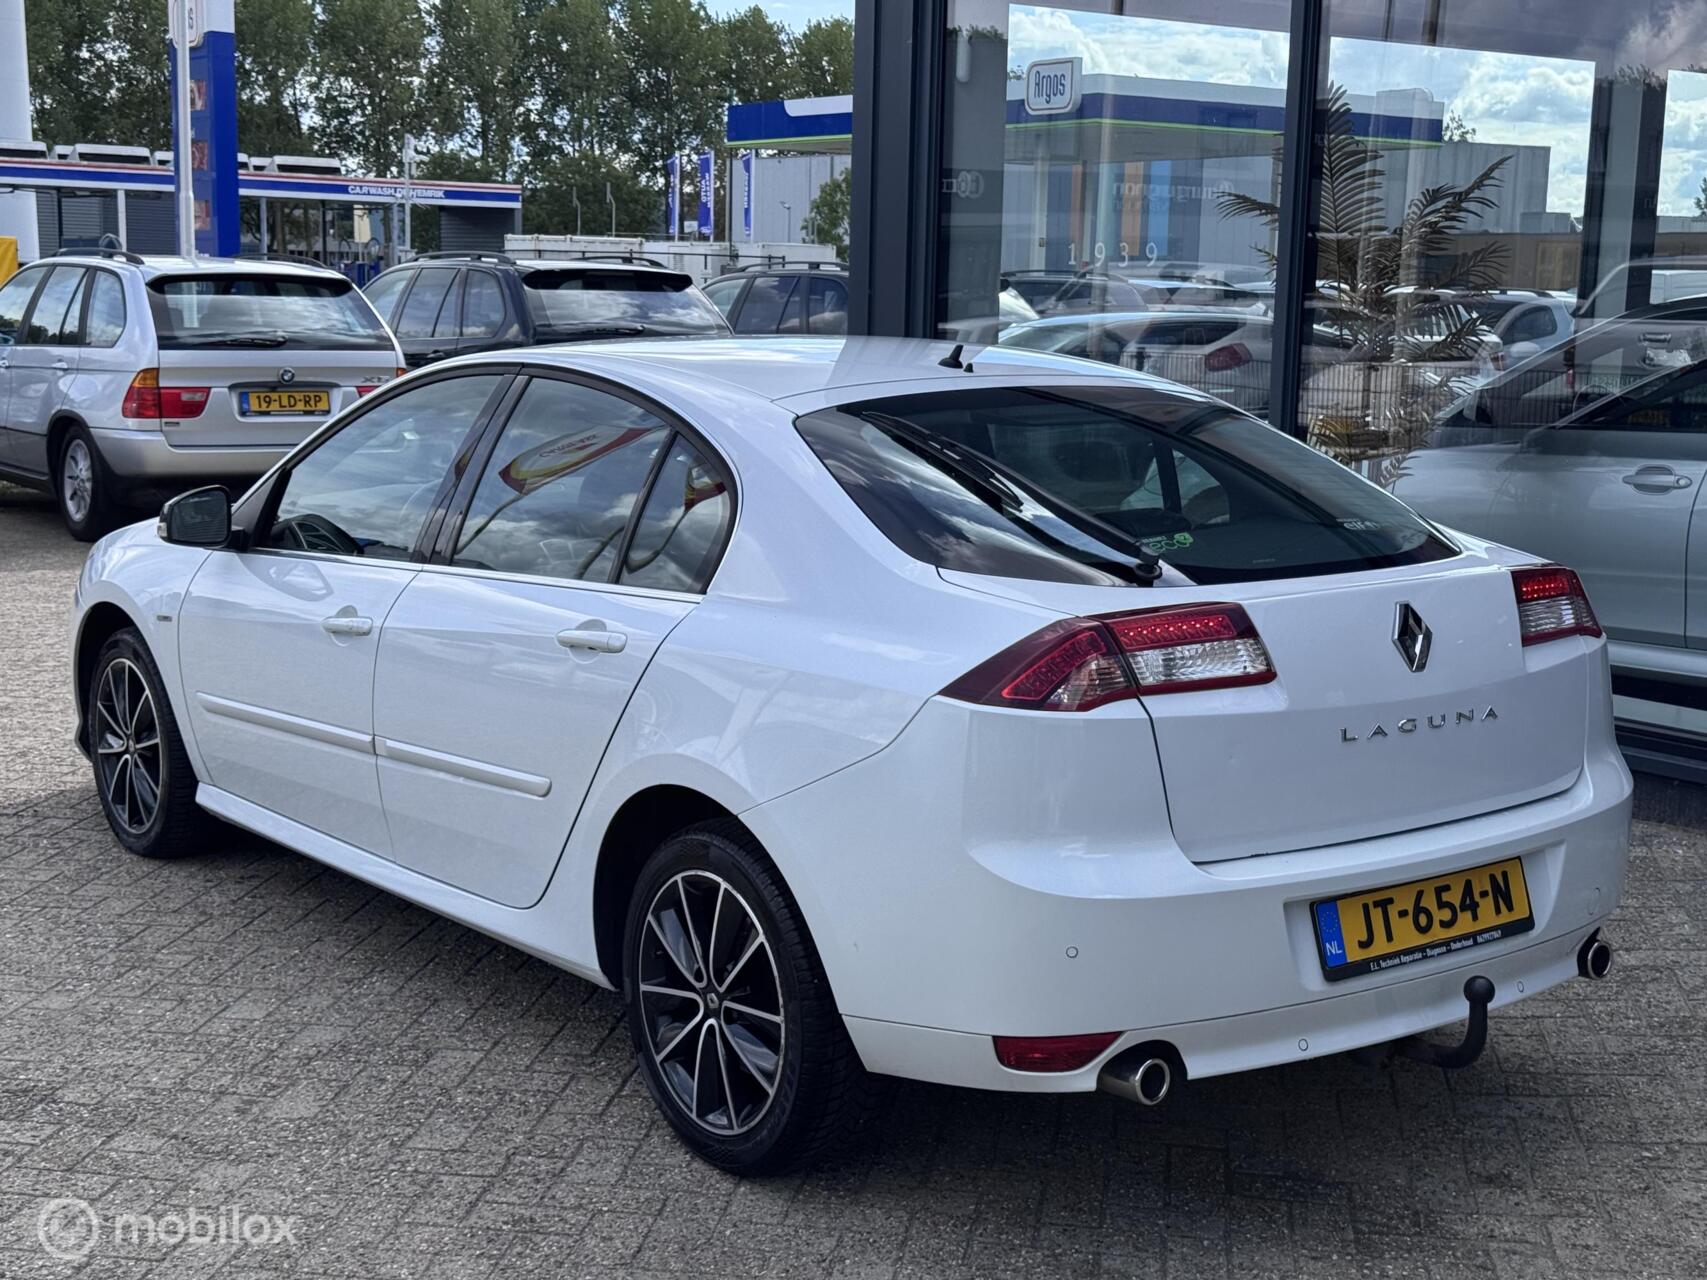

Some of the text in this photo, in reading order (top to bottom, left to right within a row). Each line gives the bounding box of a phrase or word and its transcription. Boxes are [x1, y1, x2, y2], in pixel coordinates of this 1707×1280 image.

[1033, 70, 1066, 104] Argos
[347, 185, 394, 196] CARWASH
[409, 189, 446, 198] HEMRIK
[255, 394, 323, 410] 19-LD-RP
[1340, 705, 1499, 743] LAGUNA
[1357, 870, 1515, 950] JT-654-N
[1325, 942, 1343, 957] NL
